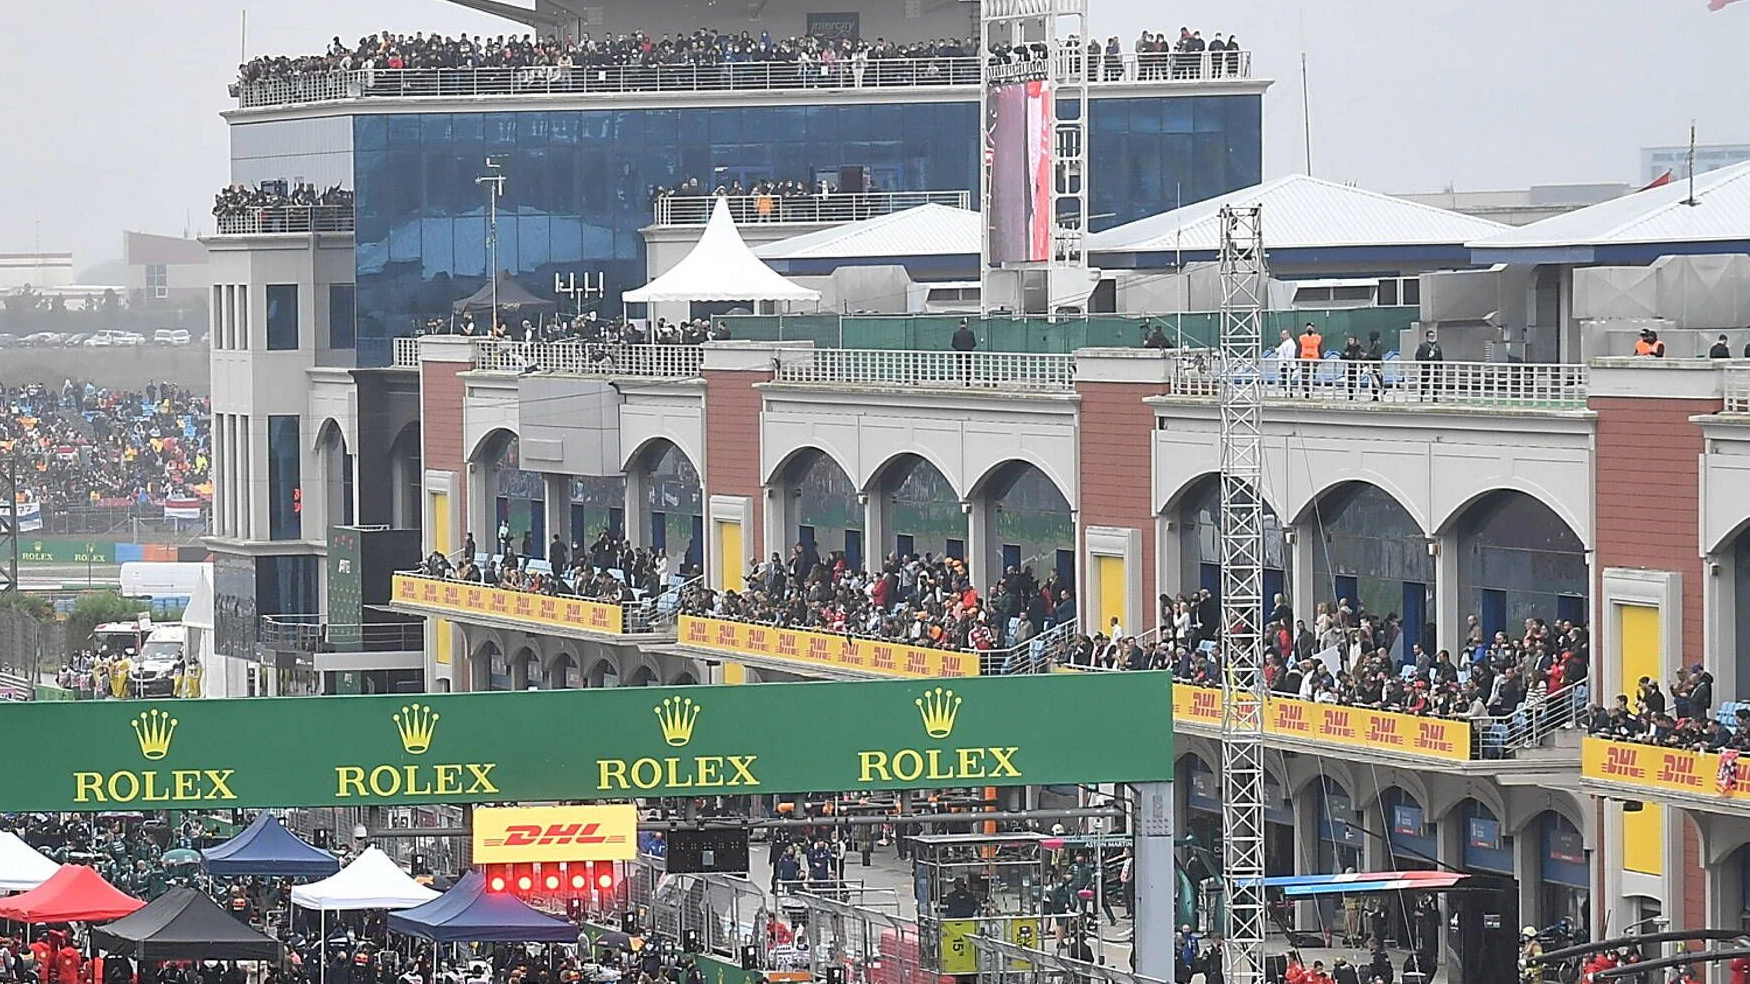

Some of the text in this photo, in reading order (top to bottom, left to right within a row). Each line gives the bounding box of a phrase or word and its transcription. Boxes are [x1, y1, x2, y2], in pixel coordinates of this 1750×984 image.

[595, 755, 761, 790] ROLEX
[857, 747, 1023, 782] ROLEX
[1608, 747, 1639, 778] DHL
[1664, 754, 1696, 785] DHL
[72, 769, 238, 803] ROLEX
[334, 763, 500, 797] ROLEX
[504, 823, 606, 846] DHL
